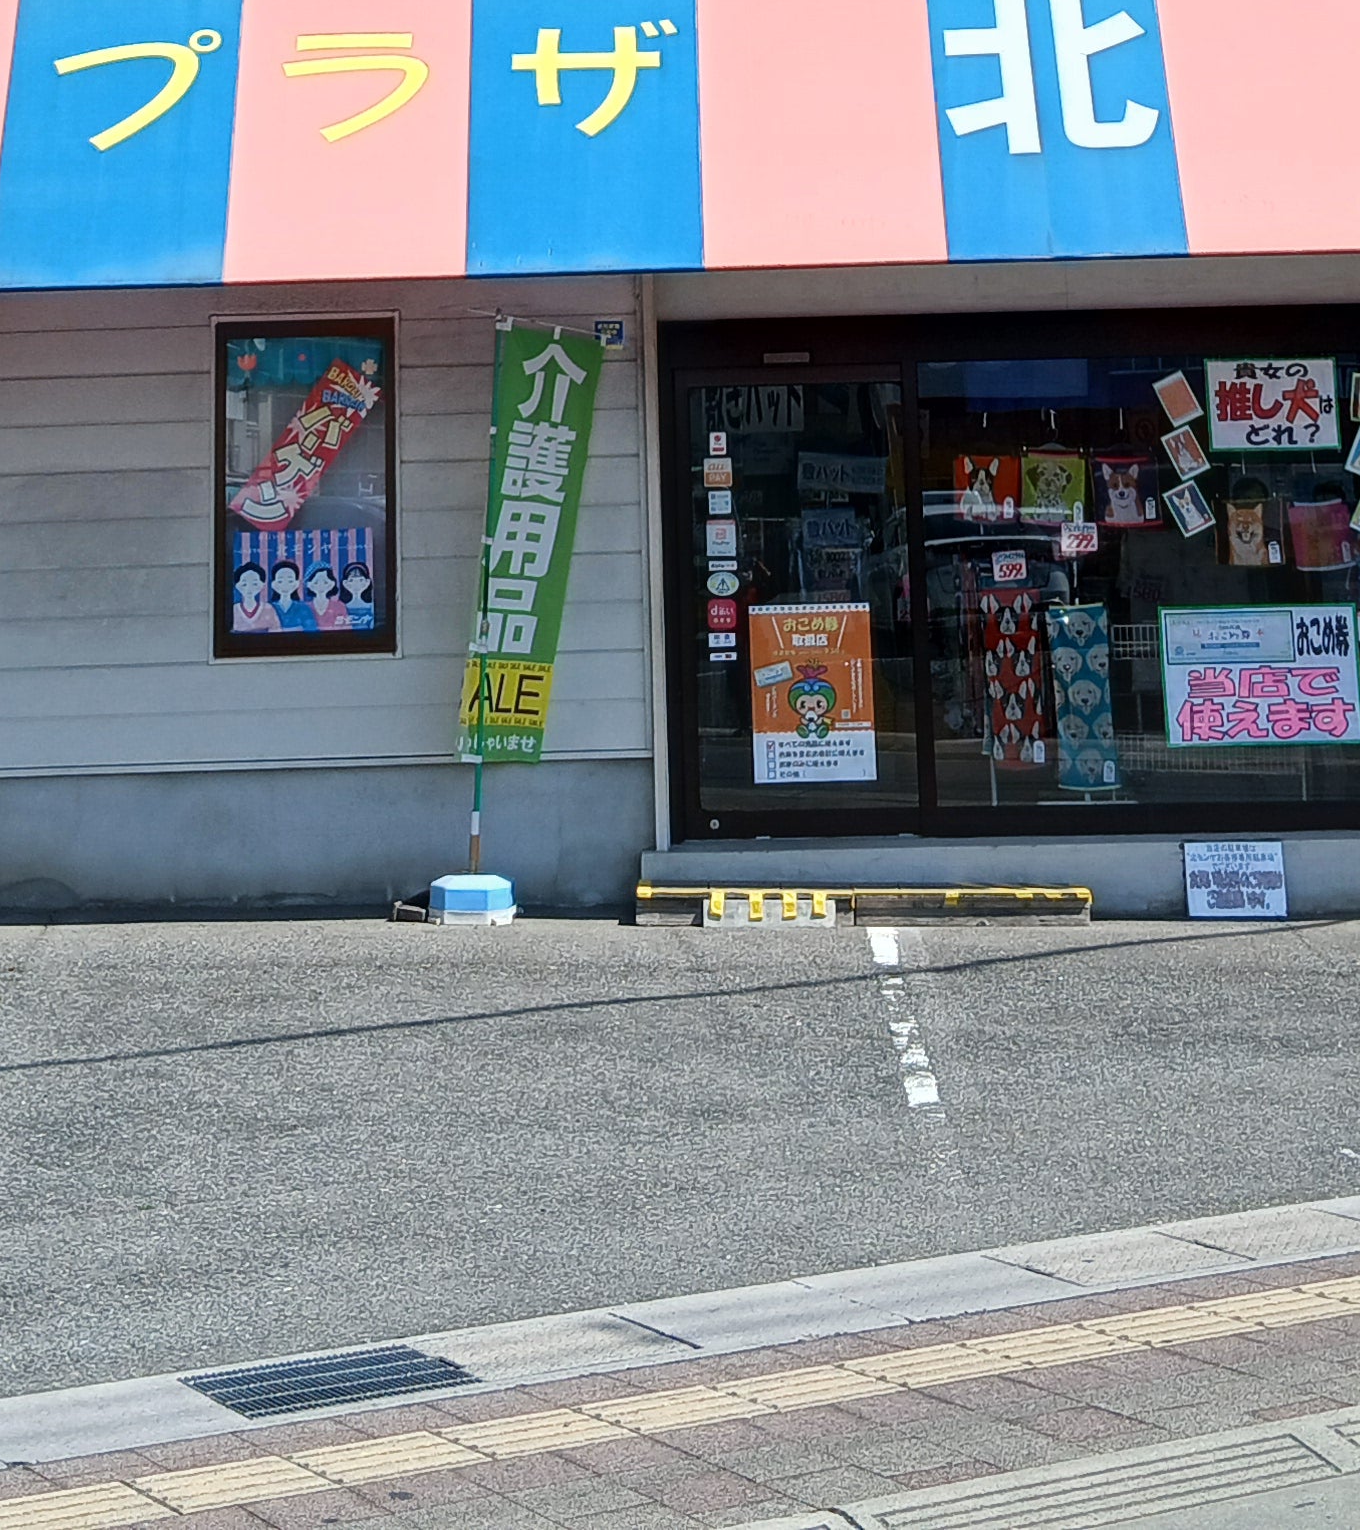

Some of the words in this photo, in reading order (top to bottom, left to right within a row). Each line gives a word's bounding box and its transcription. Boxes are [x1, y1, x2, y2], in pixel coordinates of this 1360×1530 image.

[1233, 362, 1309, 379] 貴女の
[1215, 378, 1335, 425] 推し犬は
[239, 405, 353, 523] バーゲン
[476, 342, 588, 655] 介護用品
[783, 616, 838, 632] おこめ券
[1296, 613, 1350, 657] おこめ券
[460, 671, 545, 716] ALE
[1188, 665, 1341, 699] 当店で
[1176, 697, 1356, 742] 使えます
